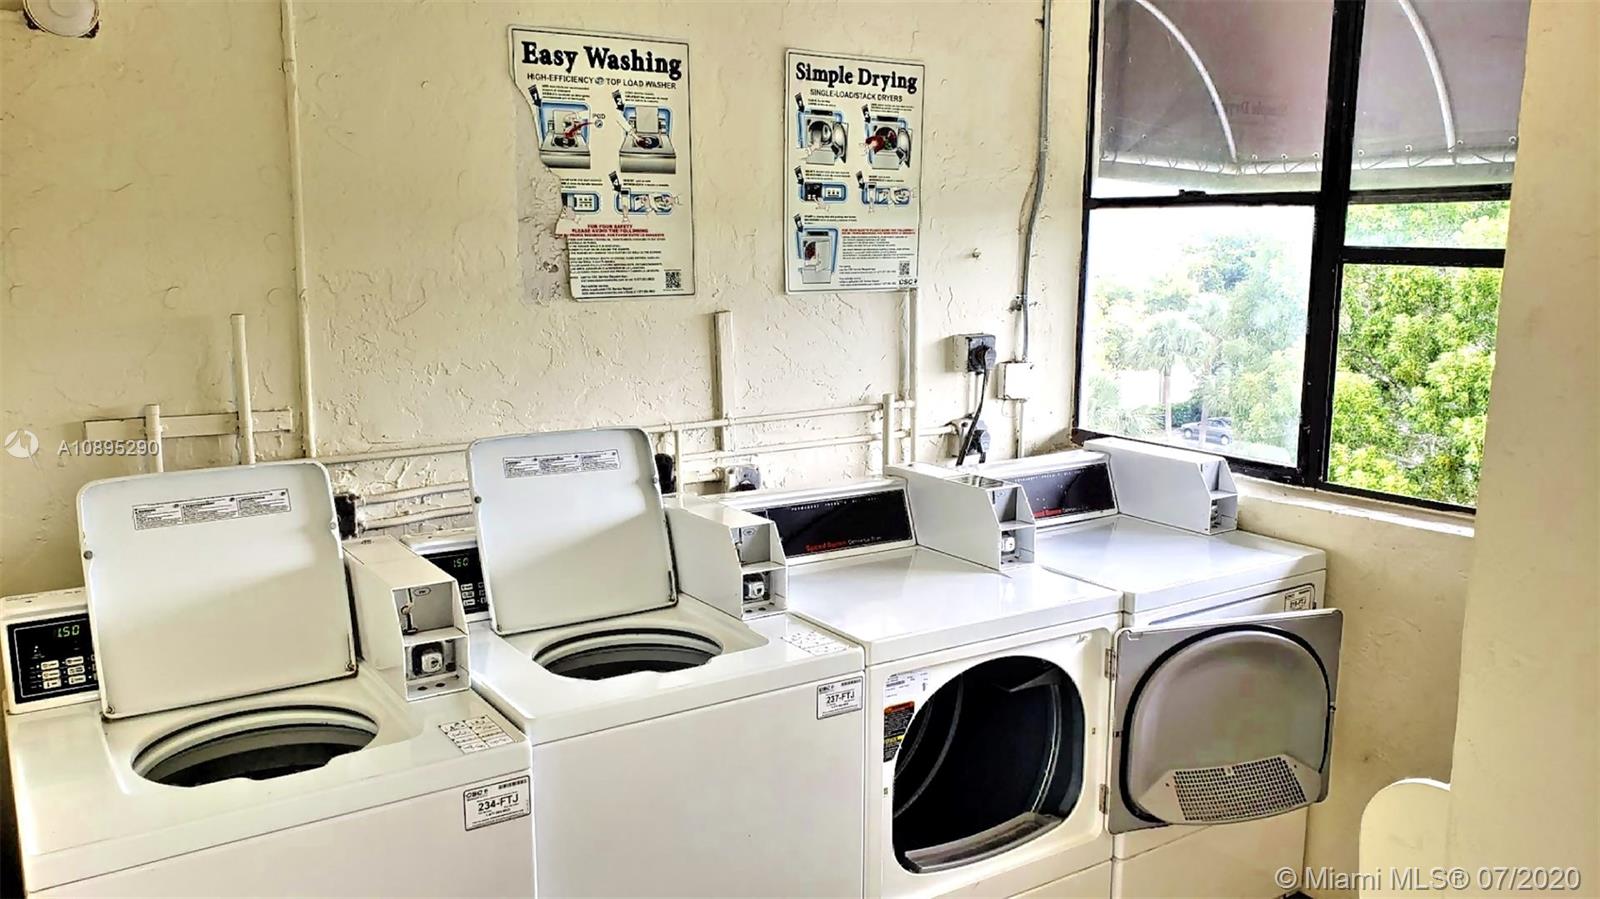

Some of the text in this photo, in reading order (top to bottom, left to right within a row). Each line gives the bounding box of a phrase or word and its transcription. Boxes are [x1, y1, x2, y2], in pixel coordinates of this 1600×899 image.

[521, 41, 682, 81] Easy Washing
[527, 73, 677, 90] HIGH-EFFICIENCY TOP LOAD WASHER
[796, 62, 918, 94] Simple Drying
[877, 94, 903, 103] DRYERS
[478, 793, 519, 812] 234-FTJ
